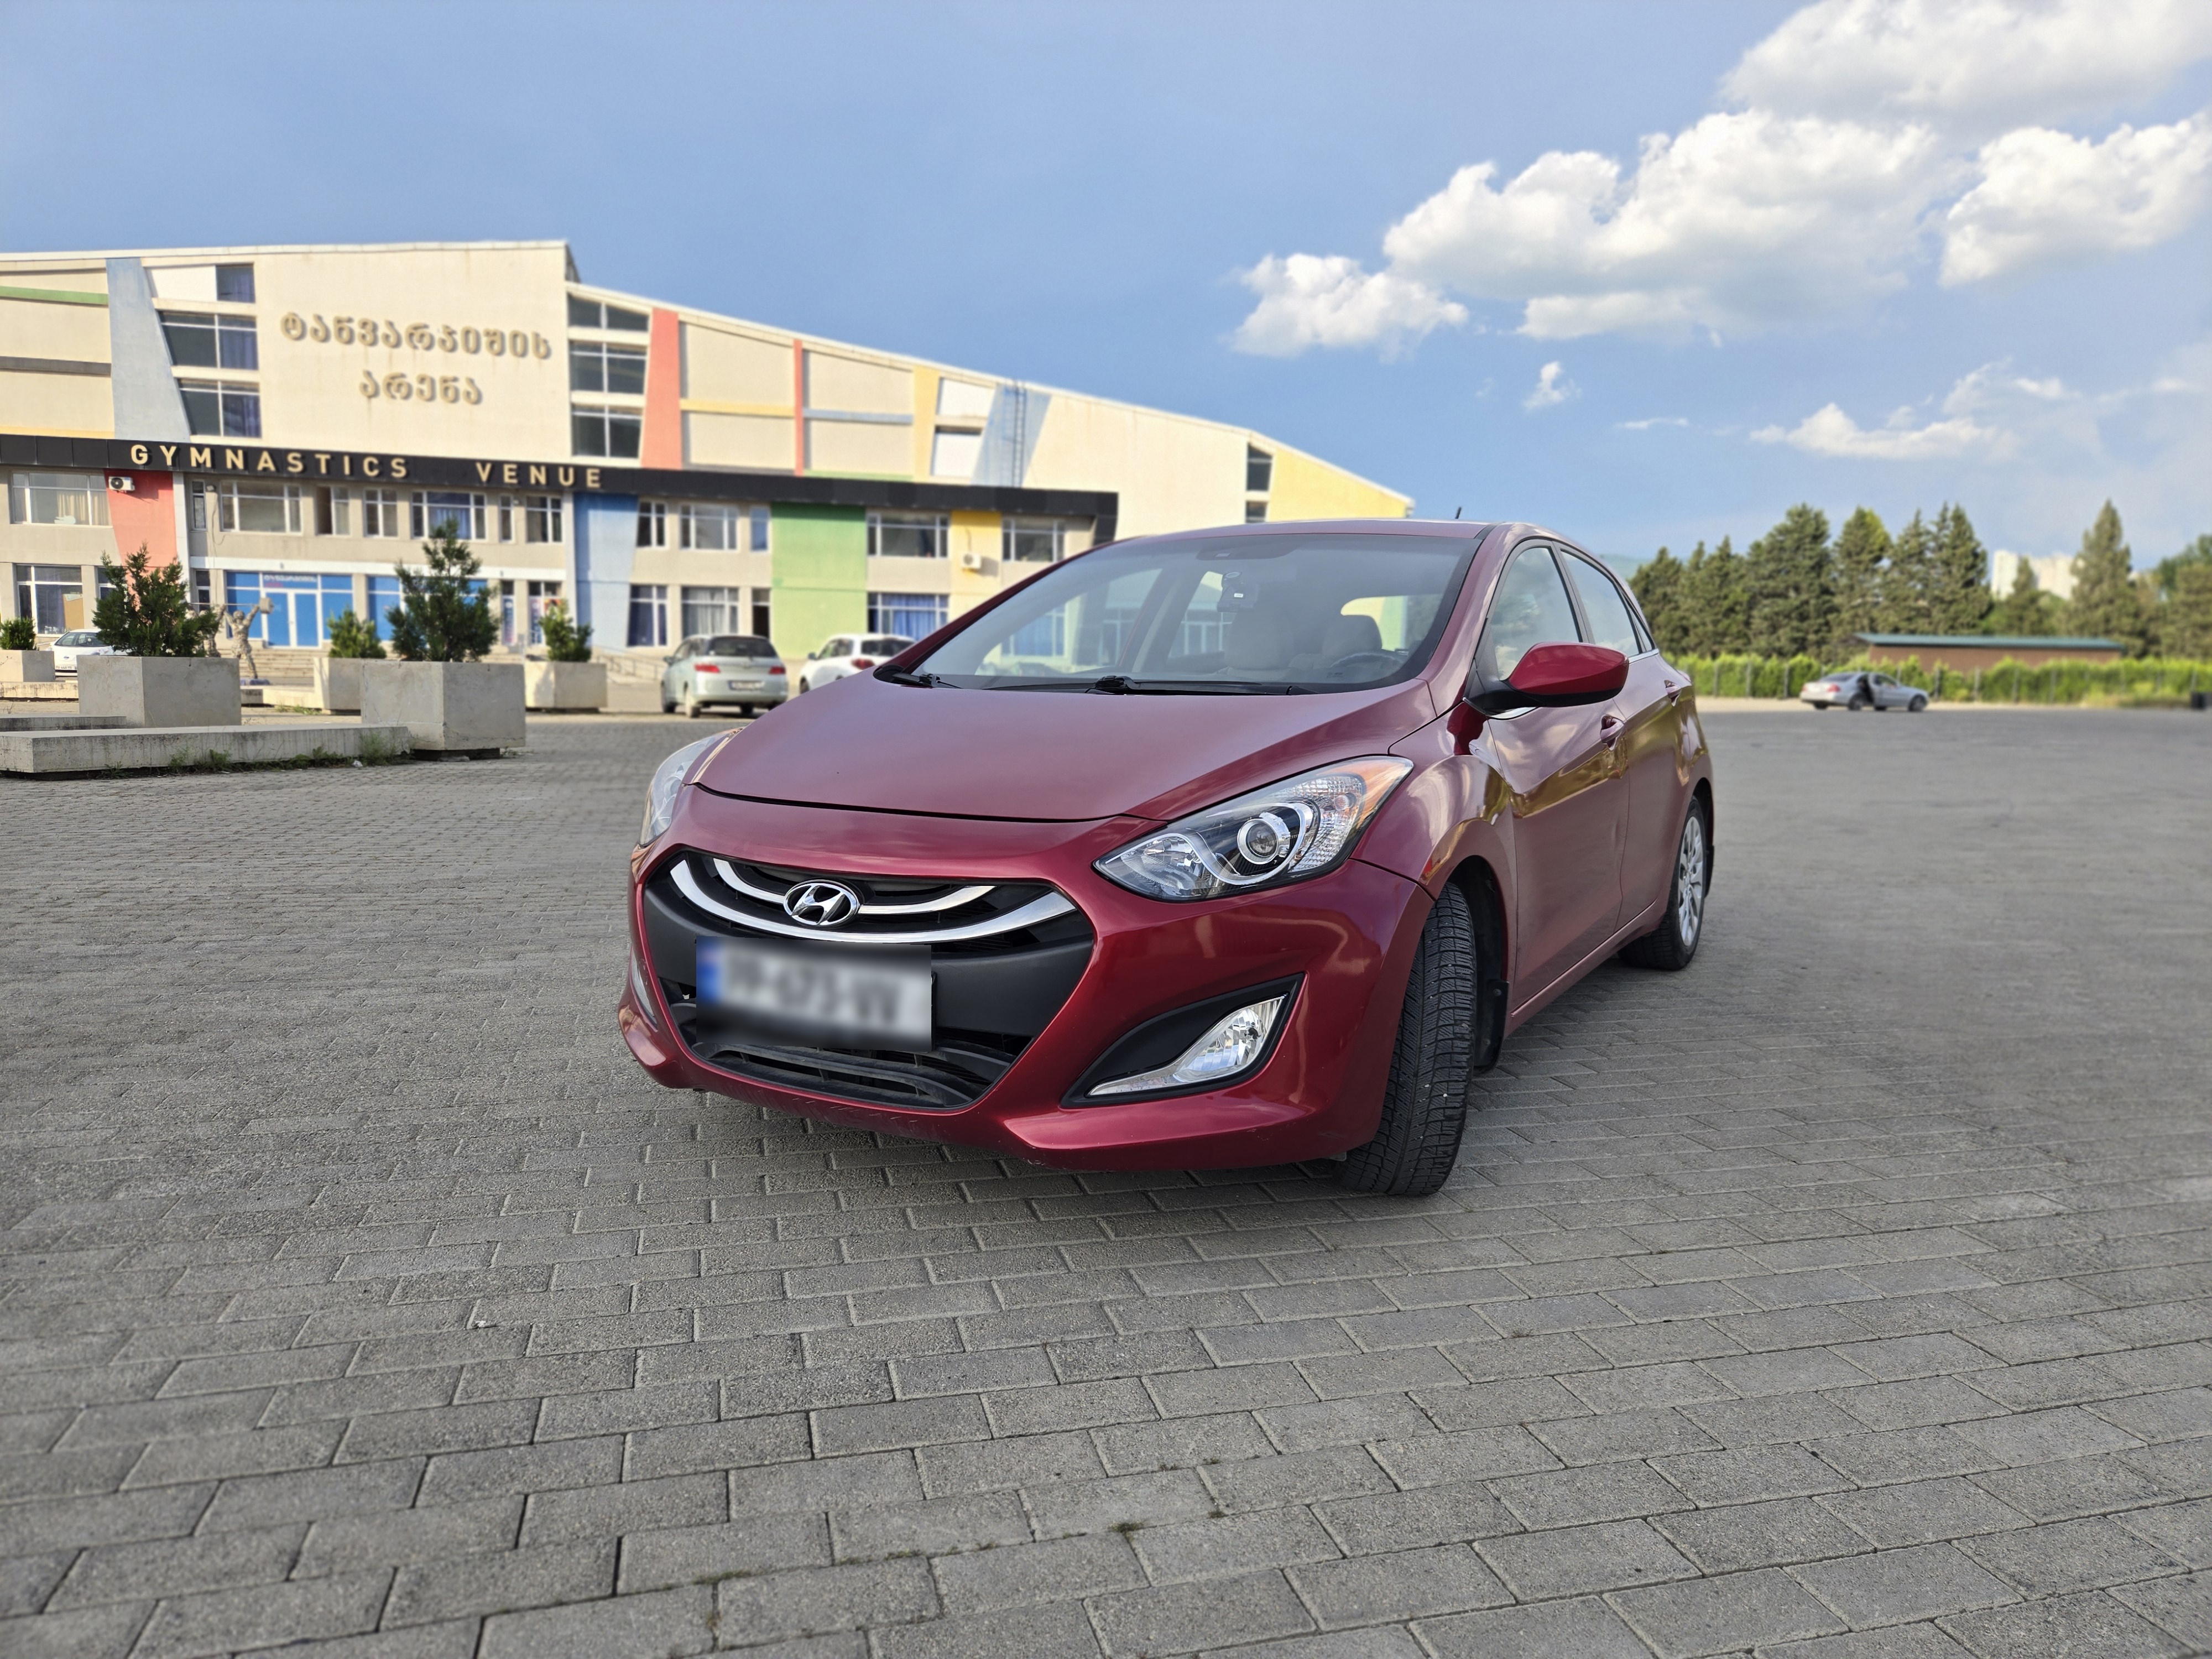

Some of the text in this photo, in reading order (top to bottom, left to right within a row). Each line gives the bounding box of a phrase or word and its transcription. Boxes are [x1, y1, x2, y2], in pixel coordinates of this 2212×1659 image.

[359, 369, 482, 405] არენა
[131, 444, 601, 488] GYMNASTICS VENUE
